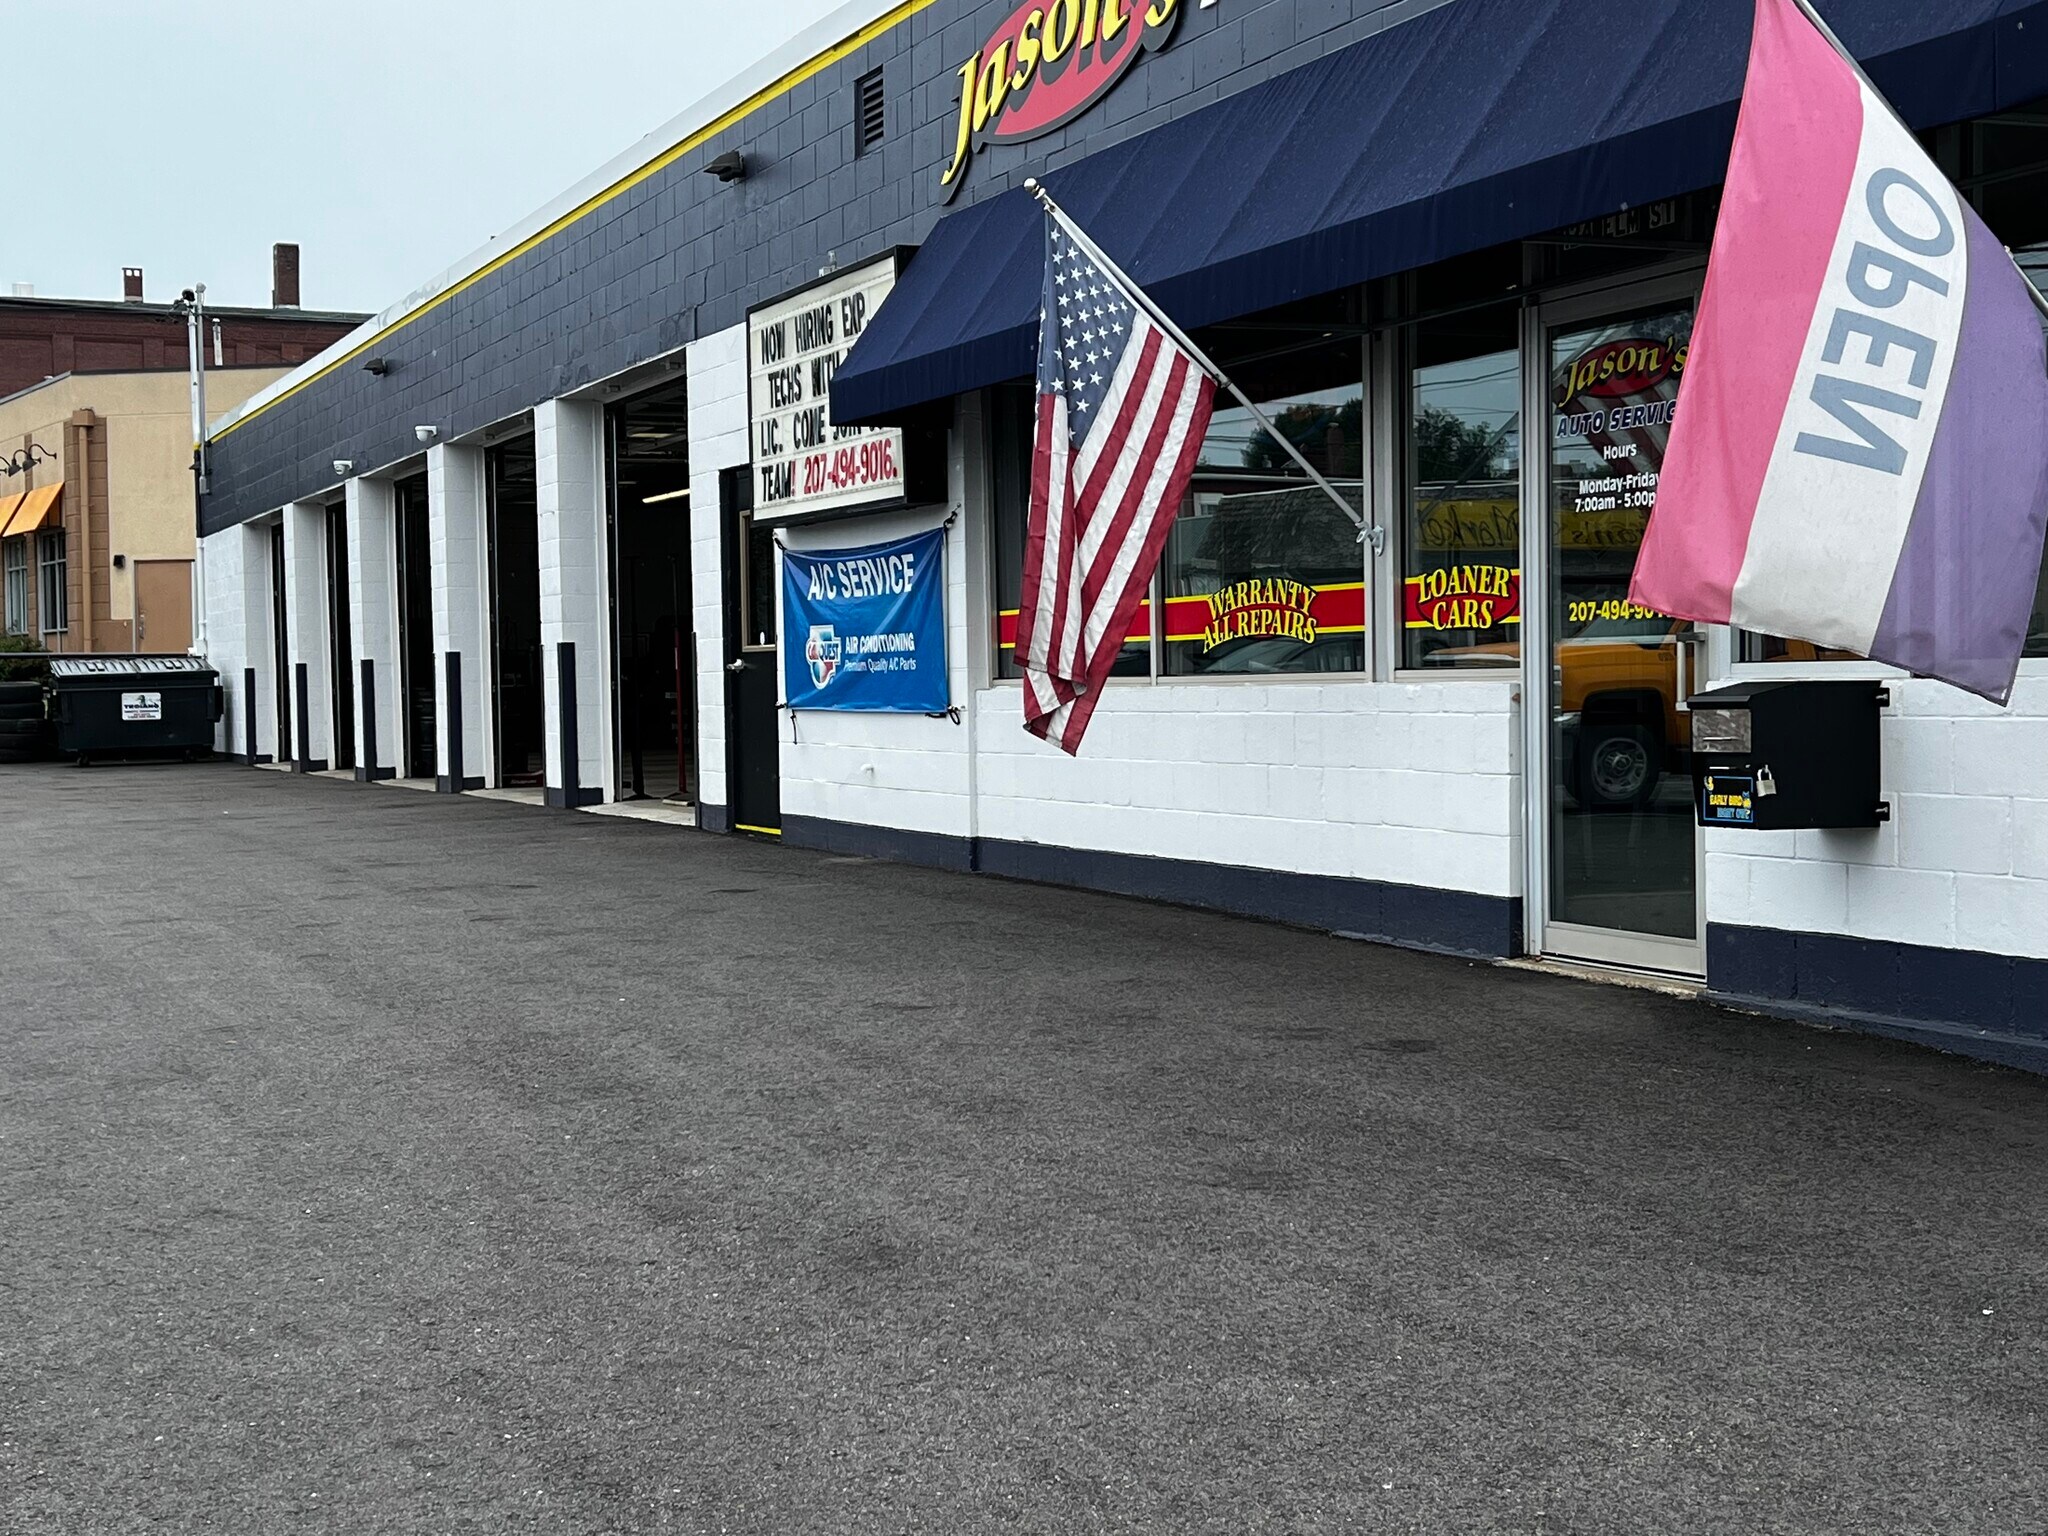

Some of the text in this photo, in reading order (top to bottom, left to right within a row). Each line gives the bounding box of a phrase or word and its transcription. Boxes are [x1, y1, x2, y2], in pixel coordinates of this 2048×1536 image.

[761, 322, 785, 365] NOW
[795, 305, 834, 354] HIRING
[768, 364, 802, 408] TECHS
[1558, 336, 1688, 408] Jason's
[761, 405, 826, 457] LIC. COME
[1555, 410, 1605, 439] AUTO
[761, 438, 897, 502] TEAM! 207-494-9016.
[1603, 444, 1637, 460] Hours
[1575, 497, 1615, 512] 7:00am
[807, 553, 914, 600] A/C SERVICE
[1418, 564, 1510, 603] LOANER
[1207, 577, 1316, 621] WARRANTY
[1432, 599, 1493, 631] CARS
[1568, 599, 1672, 622] 207-494-90
[845, 632, 915, 654] AIR CONDITIONING
[1203, 609, 1317, 655] ALL REPAIRS
[899, 657, 917, 671] Parts
